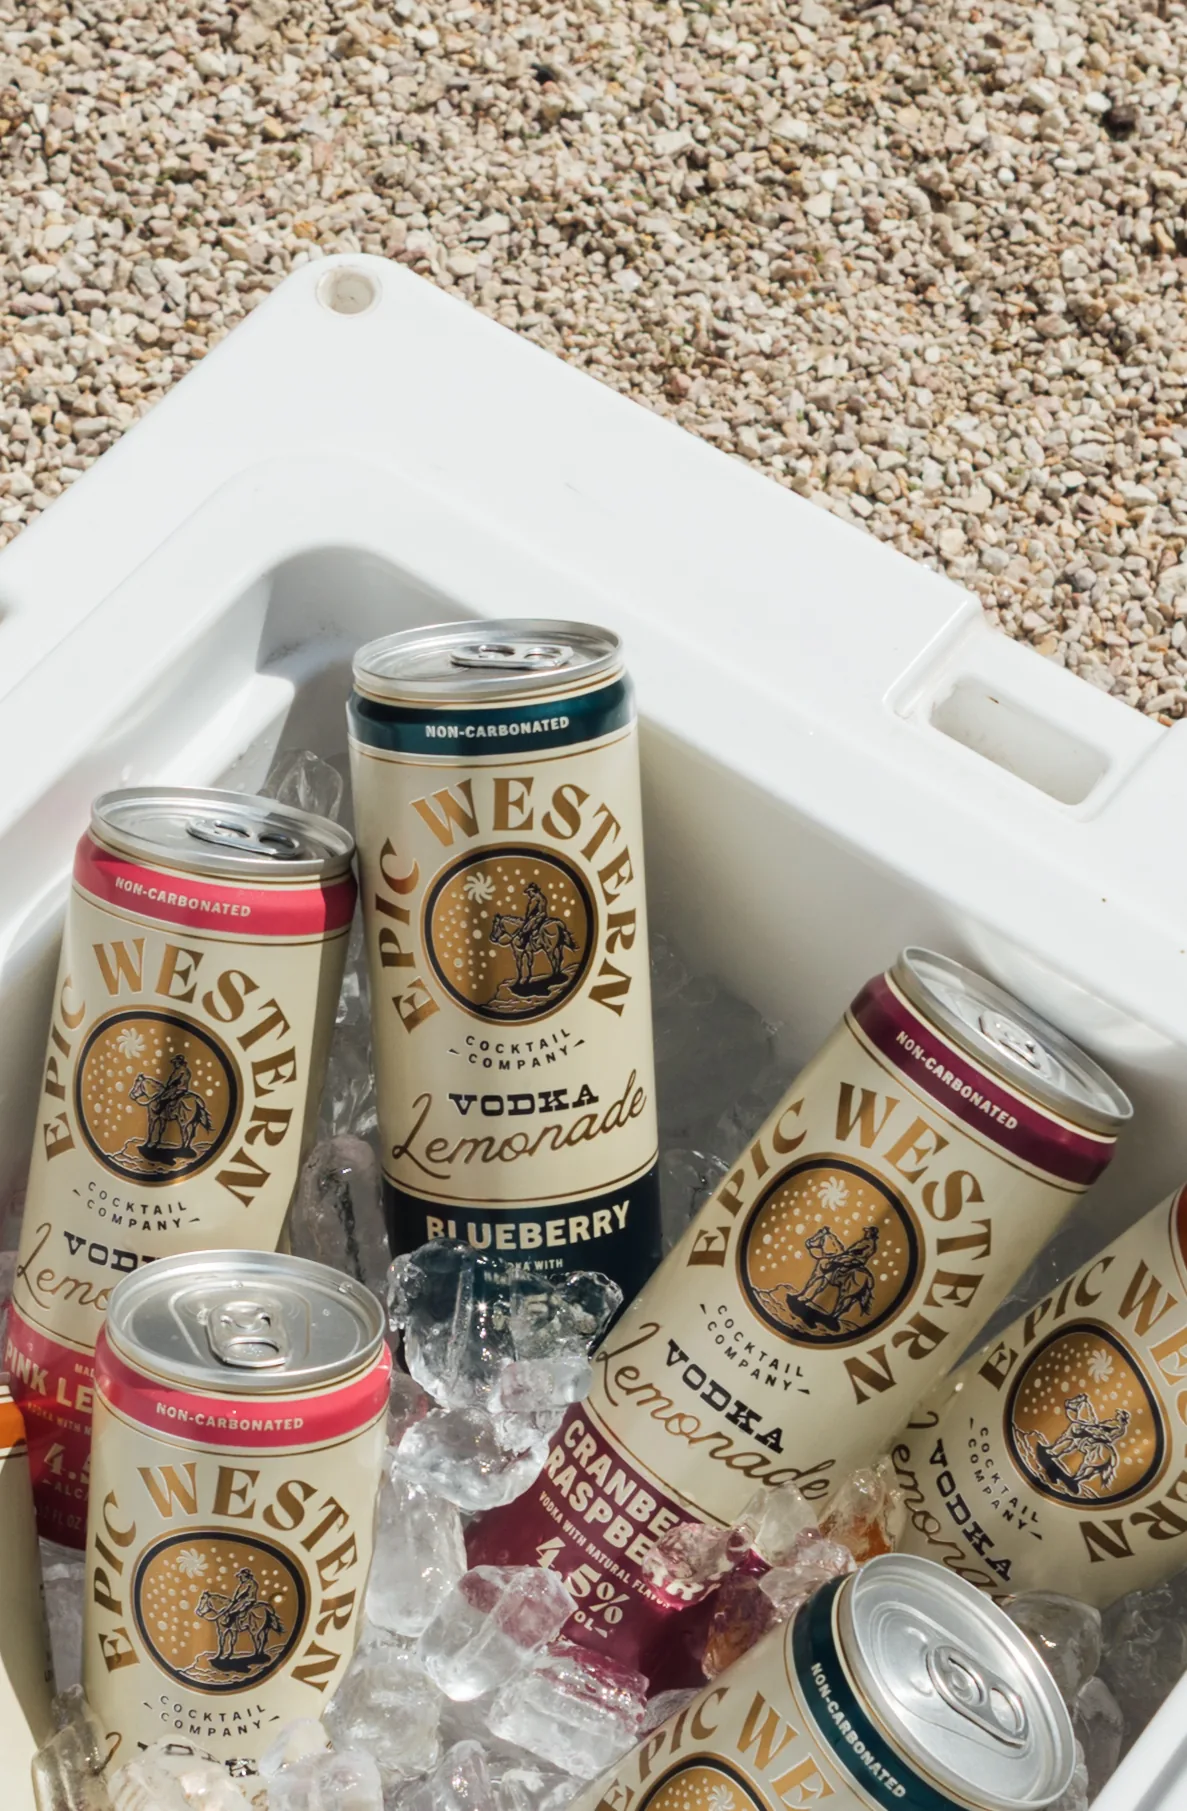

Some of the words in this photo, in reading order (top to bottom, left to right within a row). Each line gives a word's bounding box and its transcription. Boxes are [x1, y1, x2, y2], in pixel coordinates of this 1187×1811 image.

[425, 716, 570, 738] NON-CARBONATED
[115, 876, 251, 917] NON-CARBONATED
[375, 837, 441, 1034] EPIC
[409, 776, 637, 1018] WESTERN
[43, 974, 86, 1162] EPIC
[92, 937, 298, 1208] WESTERN
[465, 1029, 571, 1055] COCKTAIL
[468, 1045, 569, 1070] COMPANY
[895, 1031, 1018, 1130] NON-CARBONATED
[391, 1069, 647, 1180] Lemonade
[448, 1084, 600, 1117] VODKA
[87, 1199, 183, 1231] COMPANY
[88, 1181, 187, 1215] COCKTAIL
[686, 1098, 808, 1268] EPIC
[835, 1081, 992, 1405] WESTERN
[17, 1222, 109, 1310] Lemo
[64, 1230, 160, 1273] VOD
[534, 1258, 564, 1271] WITH
[5, 1337, 49, 1396] PINK
[707, 1320, 793, 1391] COMPANY
[717, 1304, 804, 1378] COCKTAIL
[978, 1255, 1116, 1391] EPIC
[156, 1402, 304, 1431] NON-CARBONATED
[596, 1322, 836, 1500] Lemonade
[664, 1339, 784, 1454] VODKA
[564, 1419, 680, 1540] CRANBE
[929, 1438, 1012, 1582] VODKA
[968, 1438, 1028, 1530] COMPANY
[980, 1427, 1038, 1523] COCKTAIL
[94, 1489, 140, 1674] EPIC
[136, 1462, 359, 1692] WESTERN
[539, 1490, 564, 1524] VODKA
[562, 1519, 587, 1547] WITH
[585, 1543, 632, 1584] NATURAL
[160, 1695, 266, 1722] COCKTAIL
[160, 1711, 261, 1737] COMPANY
[594, 1687, 730, 1811] EPIC
[811, 1662, 907, 1797] NON-CARBONATED
